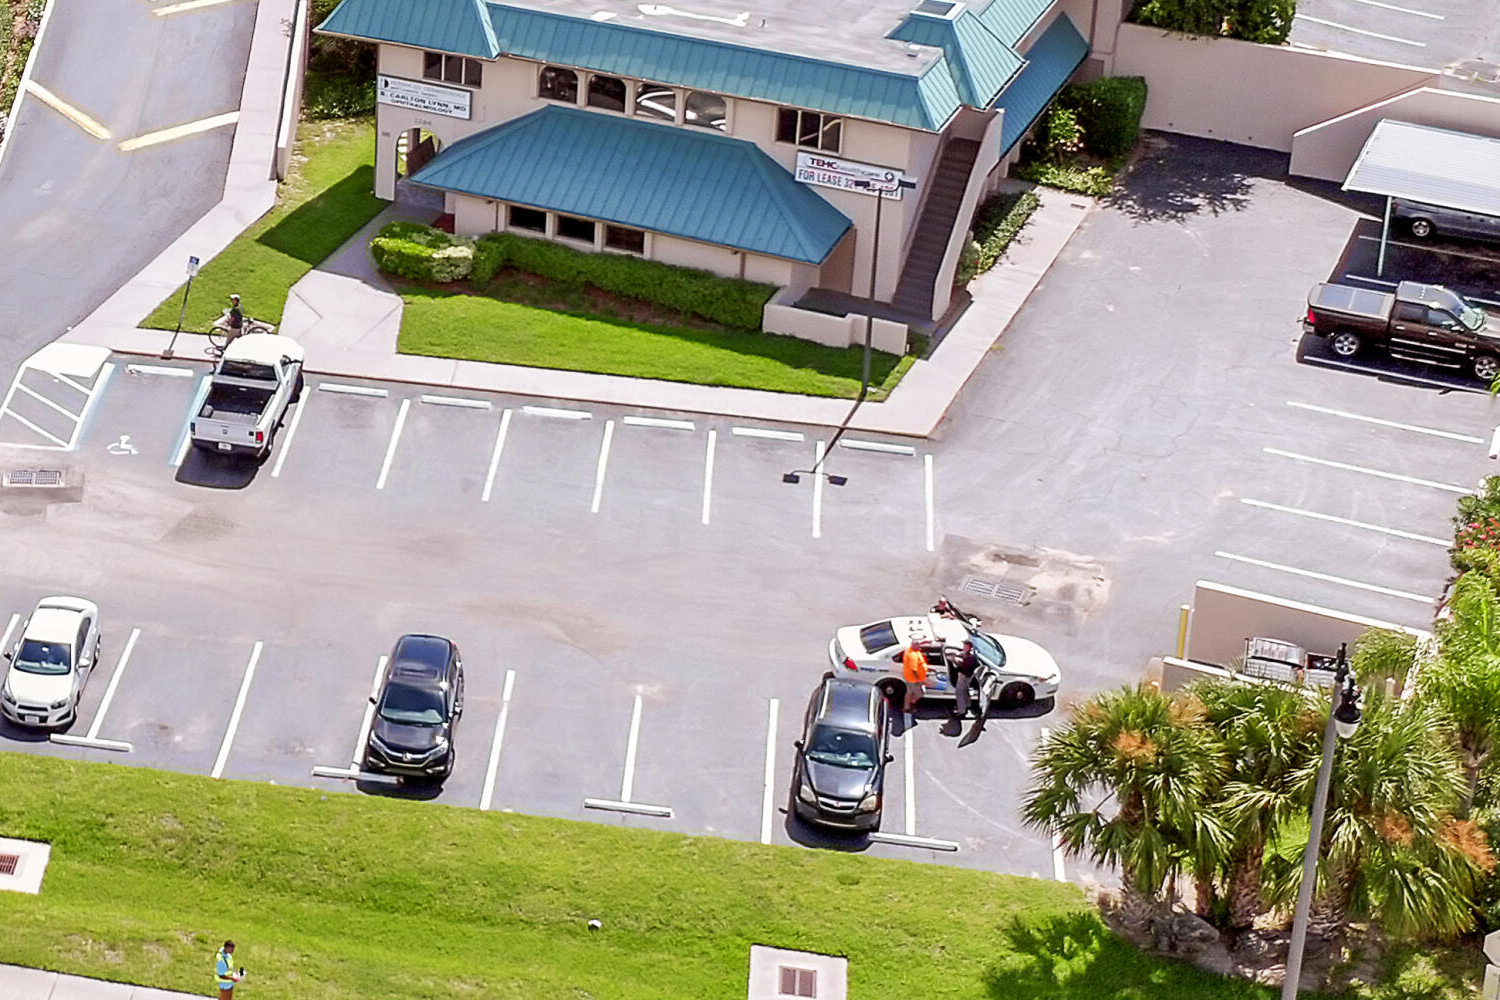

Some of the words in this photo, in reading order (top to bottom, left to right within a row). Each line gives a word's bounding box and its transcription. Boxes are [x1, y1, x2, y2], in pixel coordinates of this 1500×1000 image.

[390, 93, 426, 105] CARLTON
[798, 169, 815, 181] FOR
[817, 172, 842, 187] LEASE
